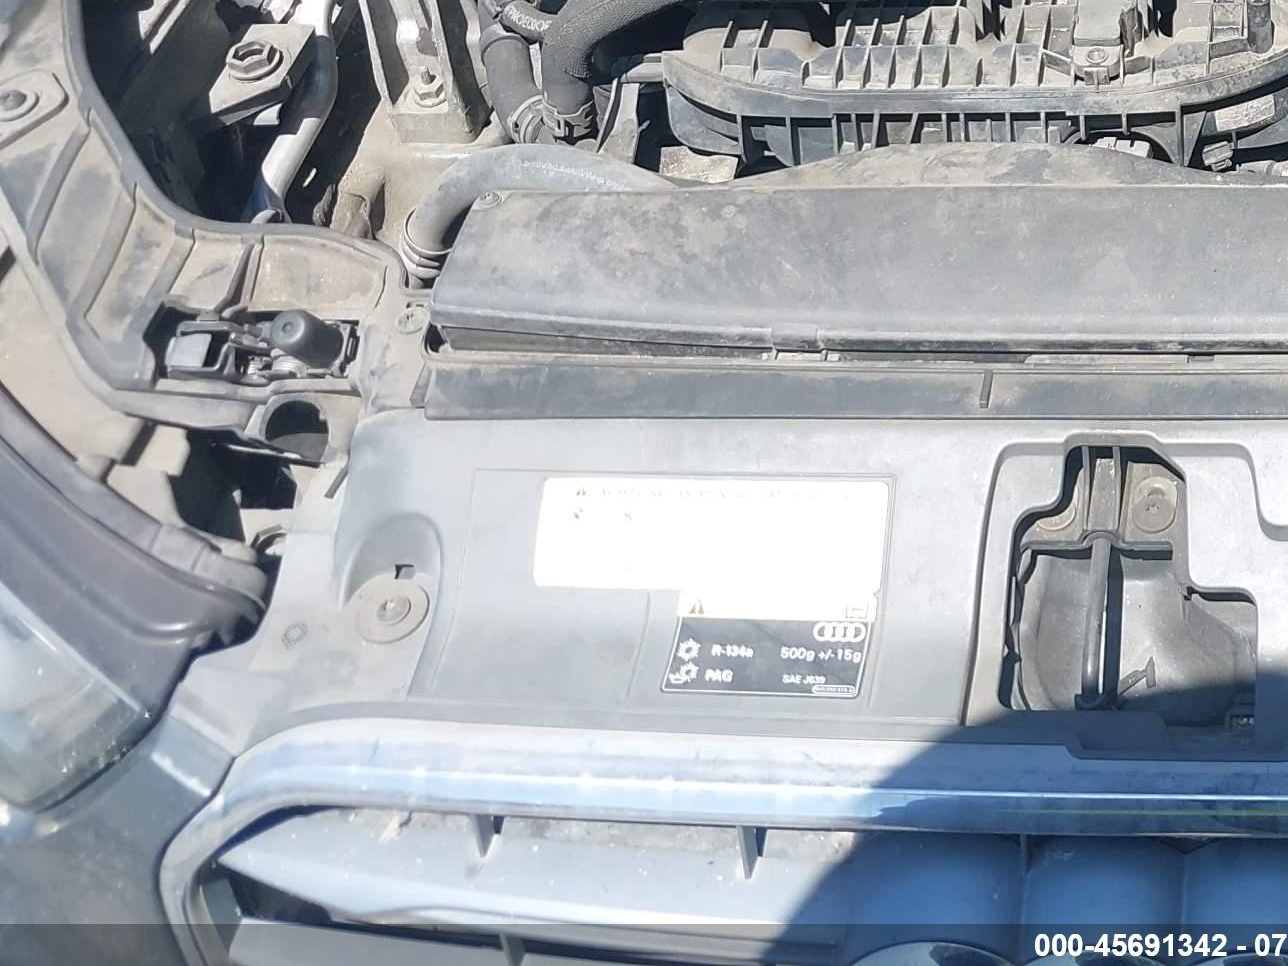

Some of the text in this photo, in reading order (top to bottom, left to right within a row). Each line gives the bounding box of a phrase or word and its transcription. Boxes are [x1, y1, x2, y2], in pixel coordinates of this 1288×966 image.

[711, 644, 862, 663] R-134a 500g +/- 15g
[704, 669, 826, 684] PAG SAE J639
